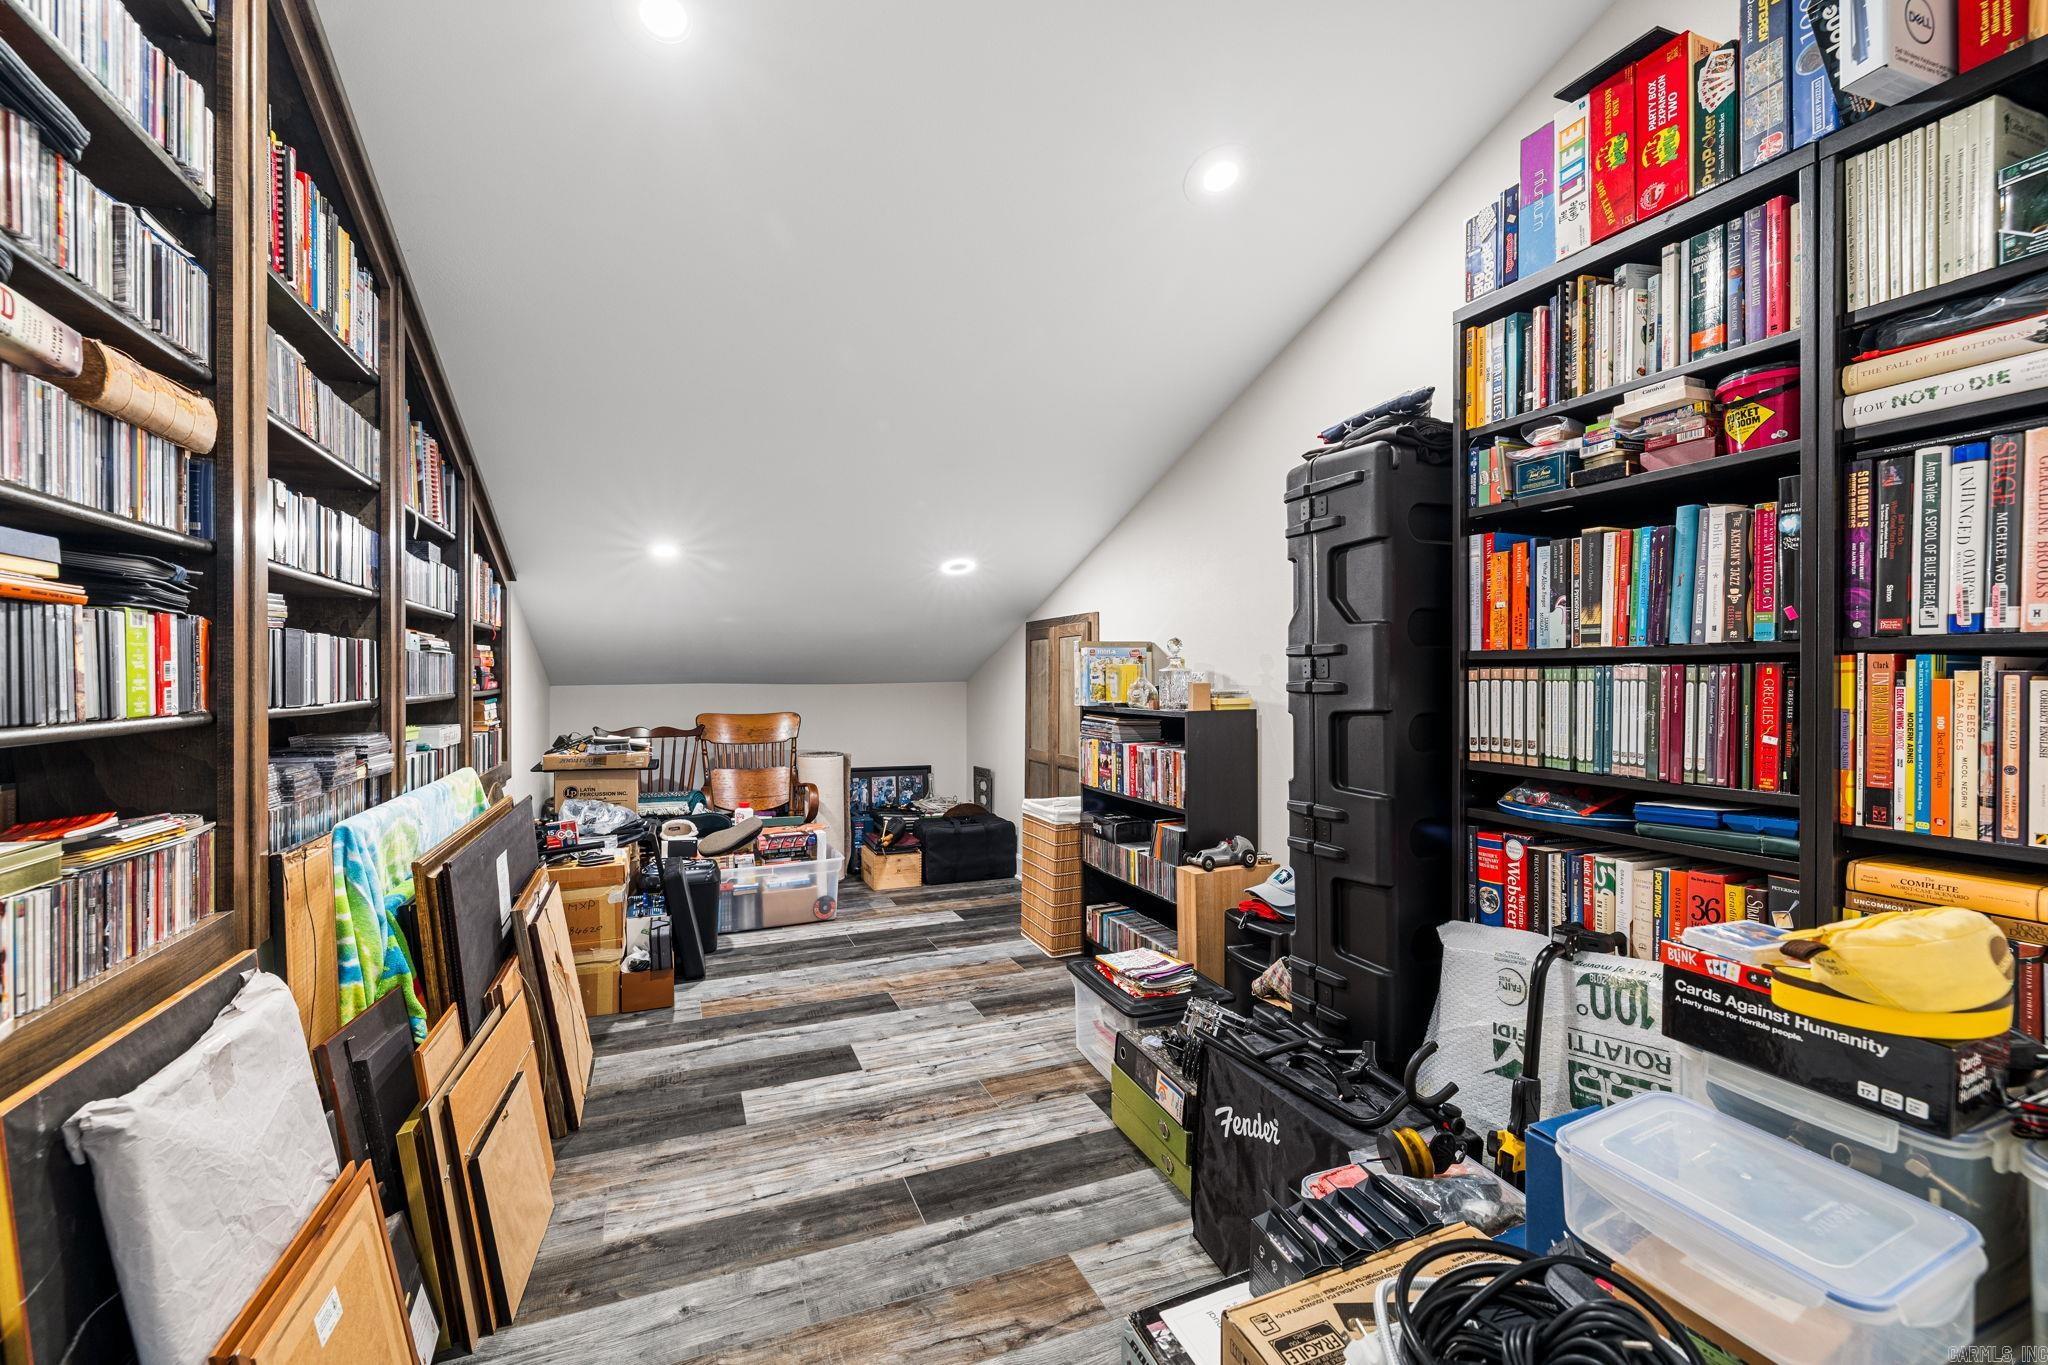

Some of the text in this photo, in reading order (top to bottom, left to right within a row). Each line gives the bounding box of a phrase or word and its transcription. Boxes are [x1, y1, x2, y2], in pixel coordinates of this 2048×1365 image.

[1908, 11, 1931, 30] DELL
[1648, 80, 1657, 131] PARTY BOX
[1658, 74, 1666, 125] EXPANSION
[1668, 92, 1677, 120] TWO
[1558, 117, 1586, 206] LIFE
[1596, 180, 1615, 225] PARTY BOX
[1729, 235, 1741, 268] PALIN
[1861, 330, 2033, 377] THE FALL OF THE OTTOMANS
[1642, 384, 1666, 395] Carnival
[1851, 401, 1887, 417] HOW
[1891, 385, 1939, 409] NOT
[1941, 384, 1964, 395] TO
[1969, 368, 2011, 390] DIE
[1924, 461, 1937, 503] Anne Tyler
[1991, 441, 2017, 508] SIEGE
[1857, 470, 1870, 527] SOLOMON'S
[1956, 466, 1976, 545] UNHINGED
[1712, 523, 1722, 549] blink
[1897, 537, 1904, 545] Do
[1925, 516, 1936, 543] SPOOL
[1995, 512, 2008, 561] MICHAEL
[2036, 456, 2048, 599] GERALDINE BROOKS
[1730, 514, 1742, 585] THE AXEMAN'S JAZZ
[1924, 544, 1936, 554] OF
[1762, 544, 1772, 610] MYTHOLOGY
[1924, 556, 1936, 577] BLUE
[1886, 584, 1894, 603] Simon
[1923, 578, 1935, 609] THREAD
[1873, 661, 1890, 669] Clark
[1762, 679, 1774, 725] GREG ILES
[1896, 688, 1905, 709] ELECTRIC
[1983, 687, 1991, 698] Cook
[1896, 710, 1904, 730] WIRING
[1955, 680, 1964, 751] PASTA SAUCES
[1967, 692, 1976, 739] THE BEST
[2039, 689, 2048, 758] CORRECT ENGLISH
[1841, 741, 1849, 751] IQ
[1934, 716, 1945, 789] 100 Best Classic Tapas
[2009, 730, 2018, 750] GOD
[1654, 872, 1662, 894] SPORT
[1890, 883, 1970, 900] WORST-CASE SCENARIO
[1899, 878, 1959, 894] COMPLETE
[568, 900, 596, 911] MXP
[1518, 894, 1526, 927] Merriam-
[1654, 894, 1662, 918] DIVING
[1690, 895, 1721, 924] 36
[1854, 898, 1904, 912] UNCOMMON
[1674, 980, 1890, 1058] Cards Against Humanity
[1682, 997, 1702, 1013] party
[1703, 1005, 1725, 1017] game
[1726, 1010, 1738, 1020] for
[1739, 1014, 1770, 1031] horrible
[1771, 1027, 1804, 1043] people.
[1567, 1032, 1672, 1074] ROIATTI
[1959, 1053, 1982, 1073] Cards
[1959, 1065, 1987, 1089] Against
[1215, 1106, 1280, 1145] Fender
[1285, 1334, 1342, 1364] FRAGILE
[1289, 1338, 1301, 1346] YOU
